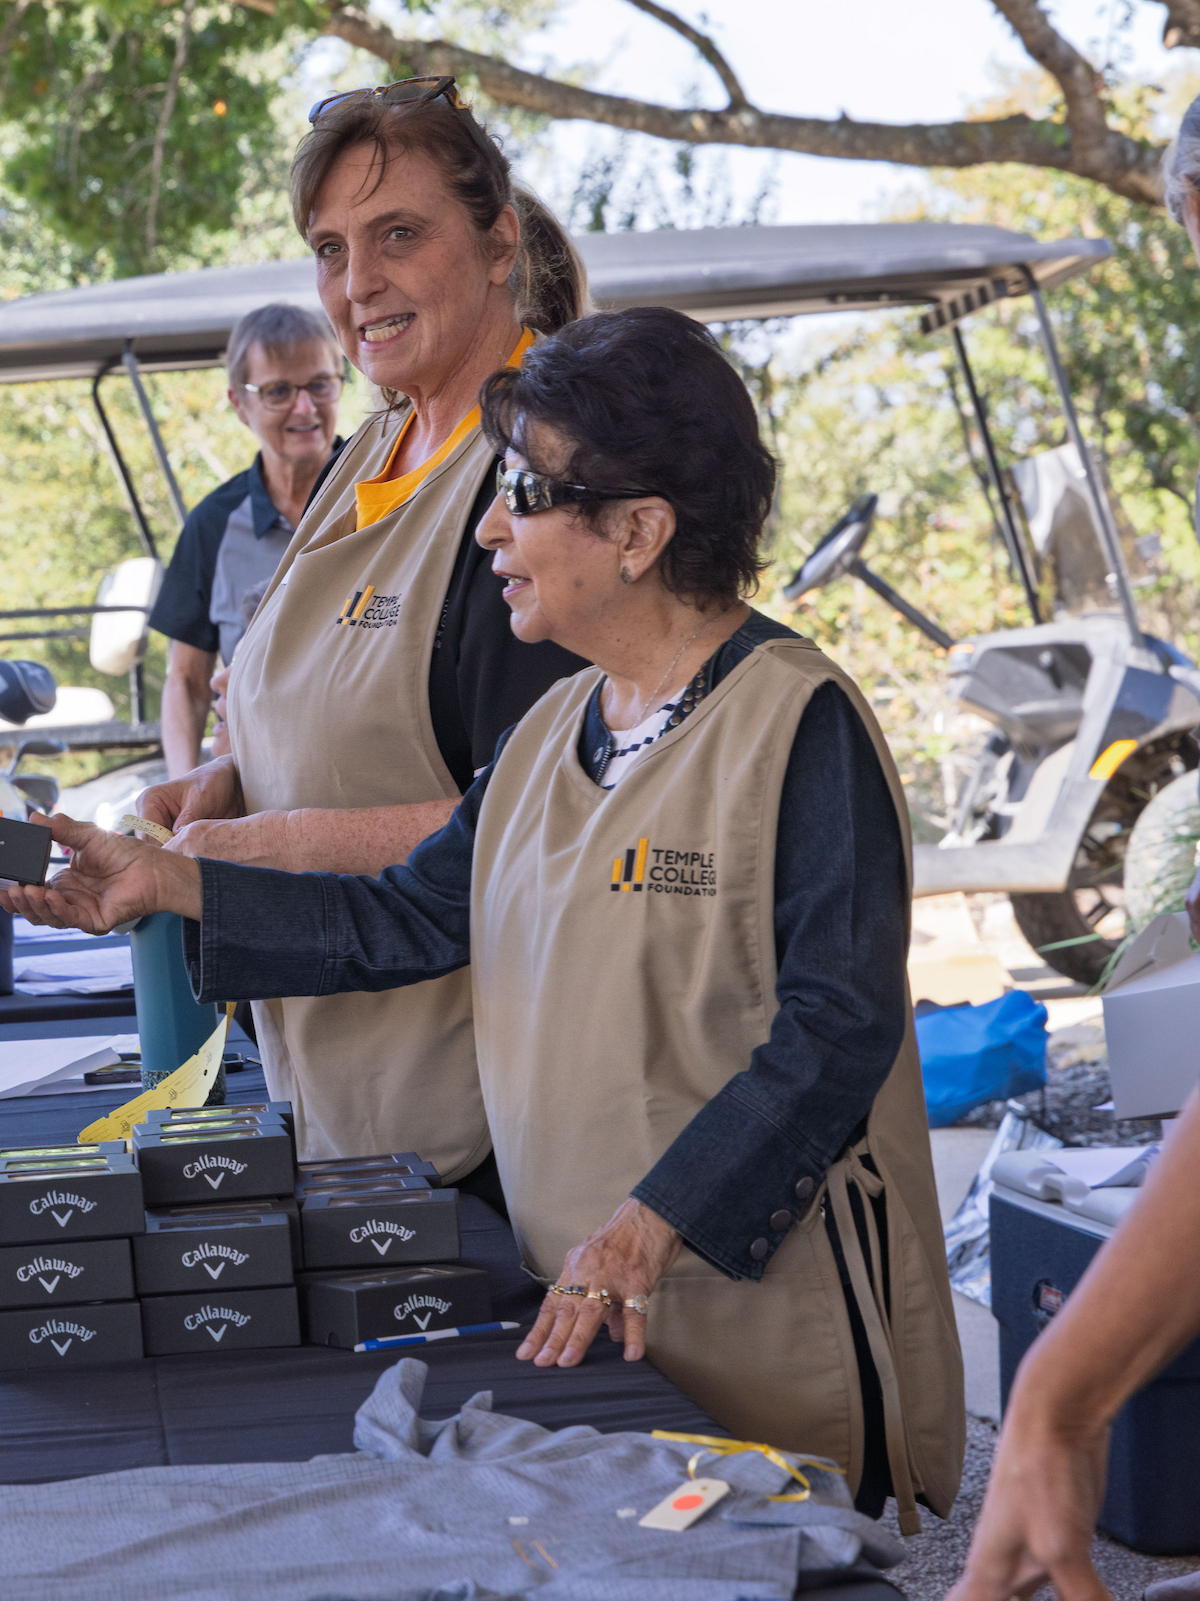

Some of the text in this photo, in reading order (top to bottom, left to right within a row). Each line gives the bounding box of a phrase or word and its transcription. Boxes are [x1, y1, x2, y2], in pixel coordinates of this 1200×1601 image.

[364, 605, 401, 620] COLLGE
[372, 594, 402, 607] TEMP
[652, 848, 714, 868] TEMPLE
[650, 866, 717, 885] COLLEG
[647, 883, 717, 896] FOUNDATIO
[182, 1154, 246, 1179] Callaway
[29, 1190, 95, 1216] Callaway
[350, 1219, 415, 1244] Callaway
[181, 1243, 247, 1268] Callaway
[16, 1256, 82, 1282] Callaway
[184, 1306, 249, 1330] Callaway
[394, 1294, 450, 1320] Callaway
[29, 1319, 94, 1344] Callaway
